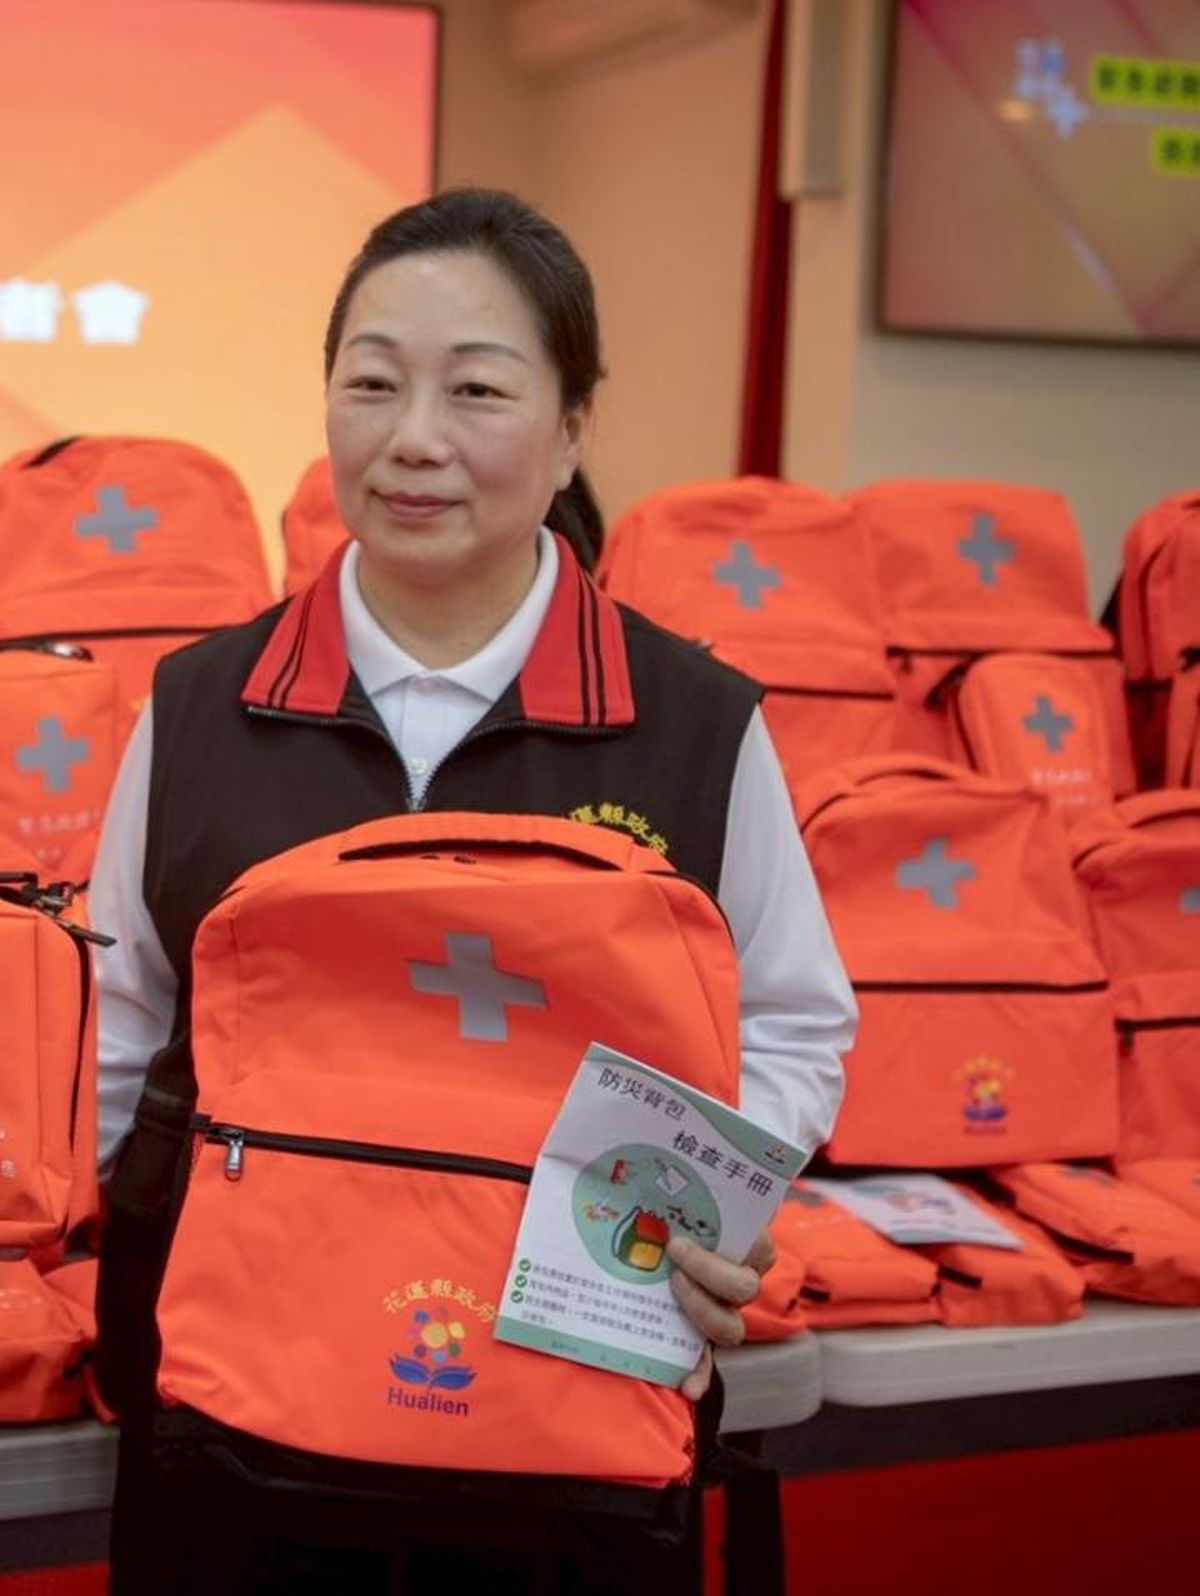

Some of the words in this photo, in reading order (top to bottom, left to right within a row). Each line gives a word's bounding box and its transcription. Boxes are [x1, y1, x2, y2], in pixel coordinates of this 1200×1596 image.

[598, 1068, 686, 1121] 防災背包
[673, 1130, 774, 1197] 檢查手冊
[387, 1386, 470, 1418] Hualien
